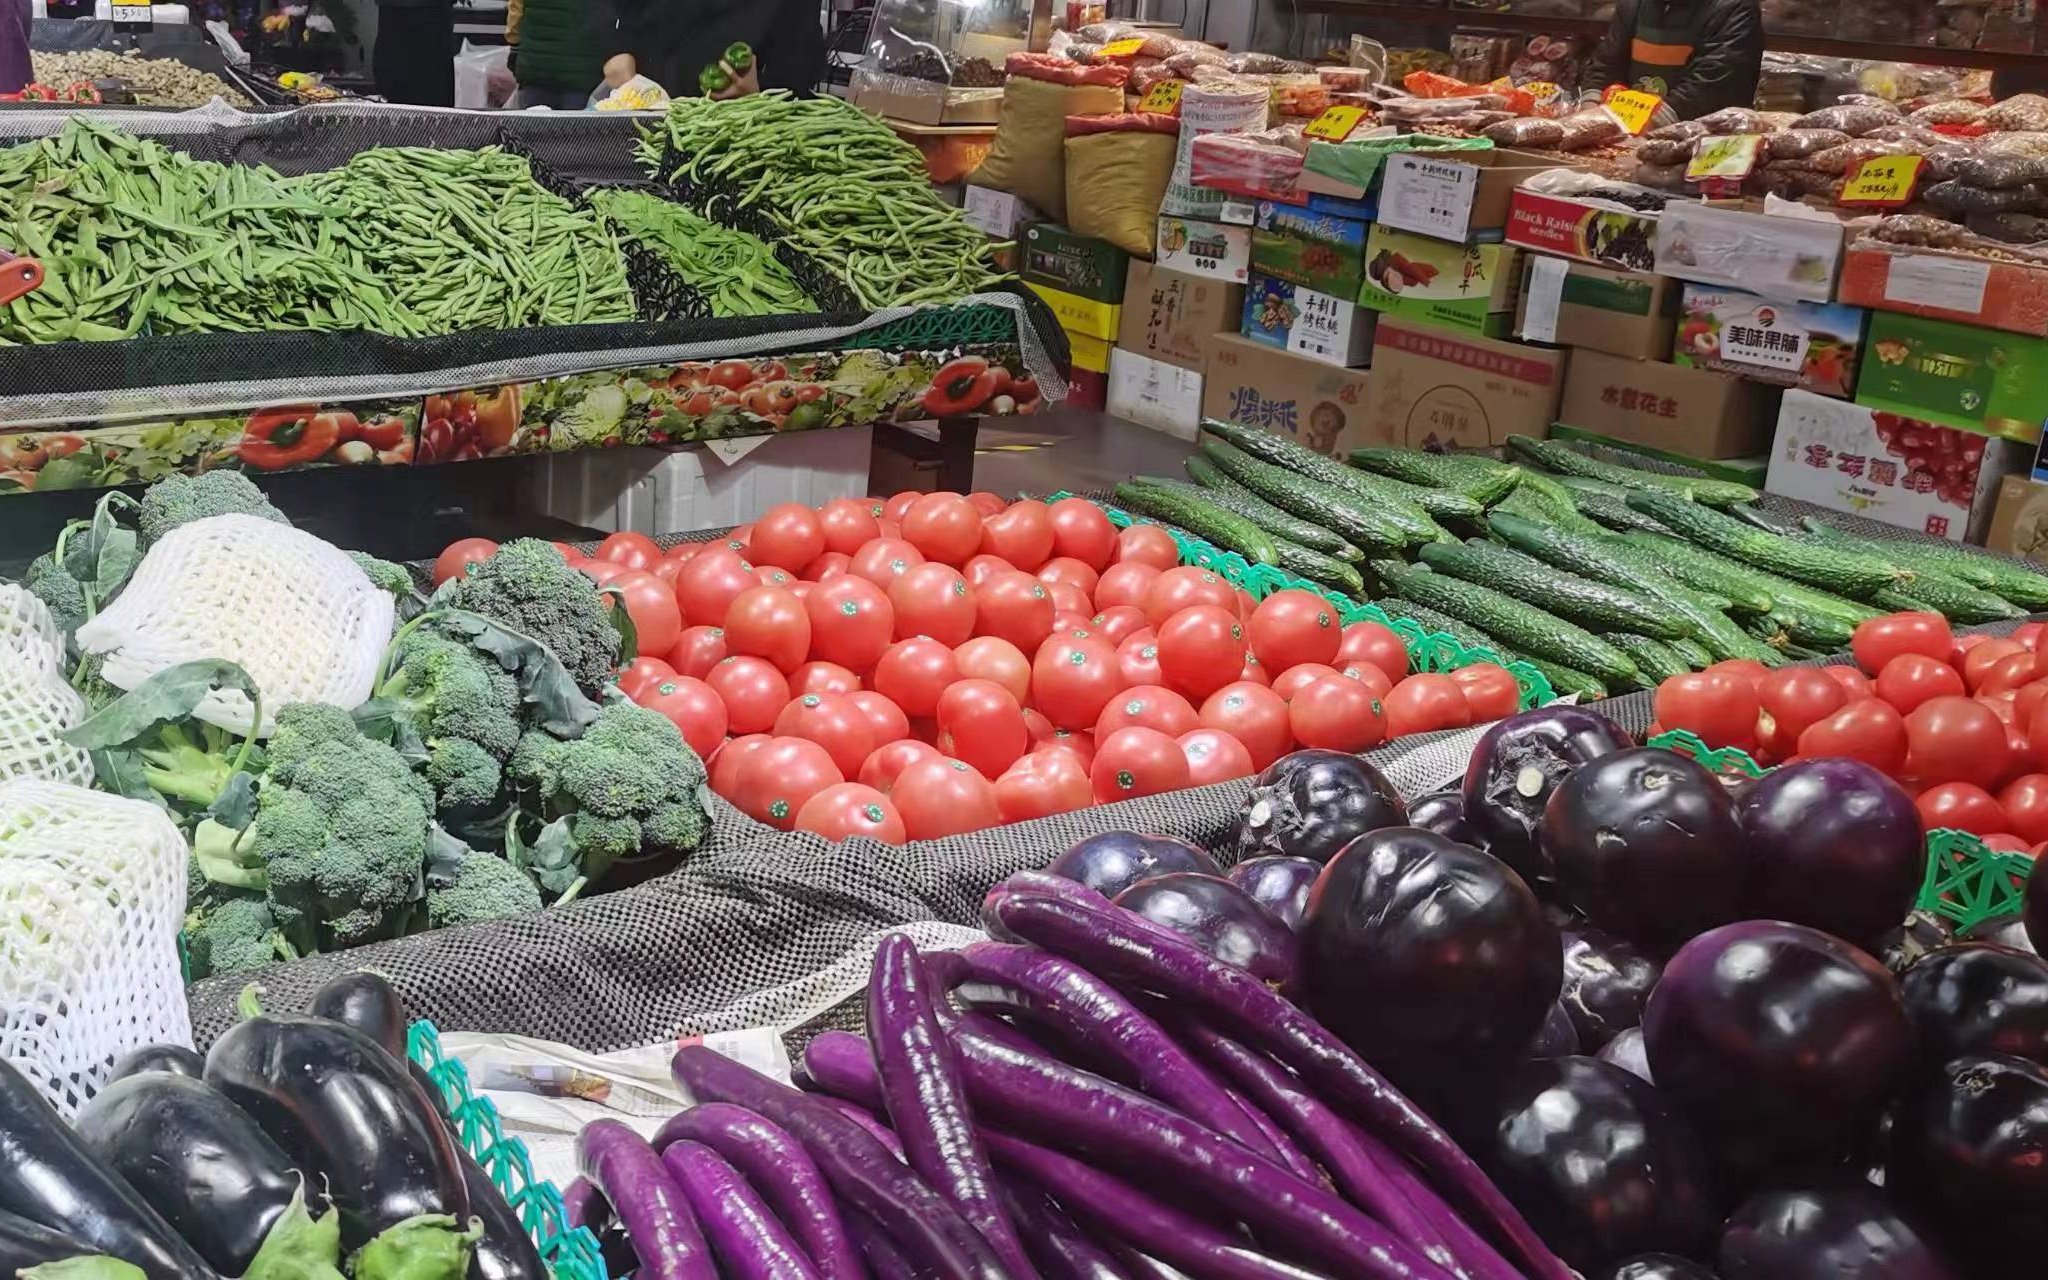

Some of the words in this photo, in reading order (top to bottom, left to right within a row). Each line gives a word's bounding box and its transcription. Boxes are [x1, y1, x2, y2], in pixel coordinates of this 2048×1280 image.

[1513, 208, 1542, 225] Black
[1167, 279, 1180, 313] 五香
[1306, 294, 1330, 315] 手剥
[1303, 312, 1339, 335] 烤核桃
[1727, 325, 1800, 354] 美味果脯
